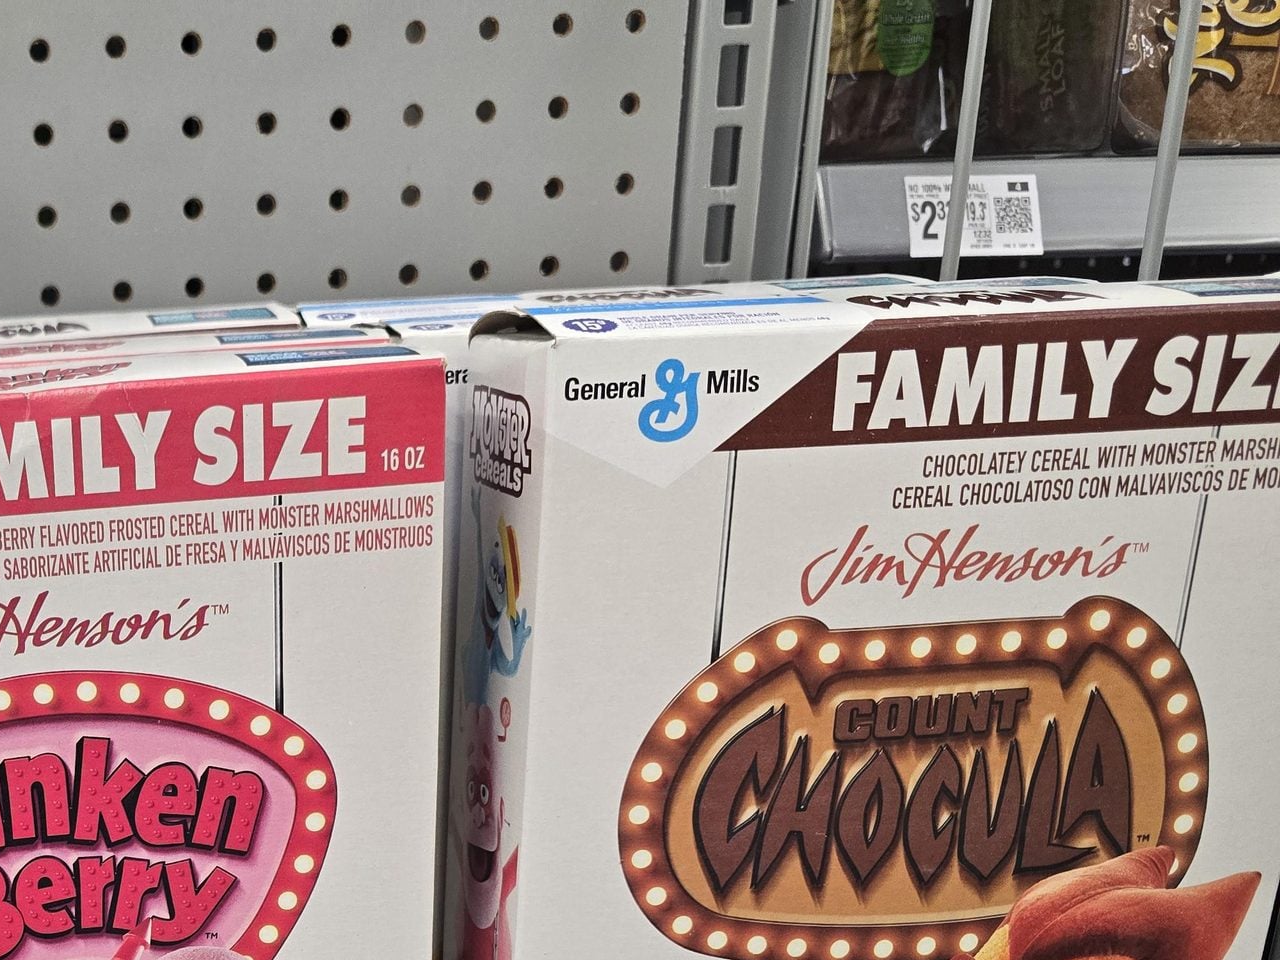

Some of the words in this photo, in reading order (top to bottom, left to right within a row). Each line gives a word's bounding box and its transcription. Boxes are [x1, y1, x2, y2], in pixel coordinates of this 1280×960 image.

[564, 374, 646, 401] General
[706, 367, 760, 395] Mills
[832, 337, 1138, 433] FAMILY
[1144, 331, 1280, 417] SIZ
[192, 395, 368, 487] SIZE
[380, 448, 399, 473] 16
[402, 446, 426, 470] OZ
[922, 450, 1027, 478] CHOCOLATEY
[1030, 447, 1090, 473] CEREAL
[1096, 444, 1136, 470] WITH
[1140, 440, 1217, 468] MONSTER
[1220, 437, 1280, 462] MARSH
[892, 484, 954, 510] CEREAL
[959, 478, 1073, 506] CHOCOLATOSO
[1078, 476, 1111, 500] CON
[1115, 469, 1223, 498] MALVAVISCOS
[1228, 468, 1250, 491] DE
[1252, 467, 1280, 490] MO
[40, 520, 105, 548] FLAVORED
[108, 516, 166, 542] FROSTED
[169, 512, 218, 537] CEREAL
[222, 509, 254, 533] WITH
[258, 503, 320, 530] MONSTER
[324, 494, 434, 525] MARSHMALLOWS
[3, 552, 90, 580] SABORIZANTE
[93, 546, 162, 573] ARTIFICIAL
[166, 543, 182, 567] DE
[185, 541, 227, 566] FRESA
[230, 540, 238, 562] Y
[242, 533, 330, 561] MALVAVISCOS
[334, 532, 351, 553] DE
[354, 525, 434, 551] MONSTRUOS
[800, 524, 909, 606] Jim
[832, 686, 1031, 744] COUNT
[692, 685, 1133, 893] CHOCULA
